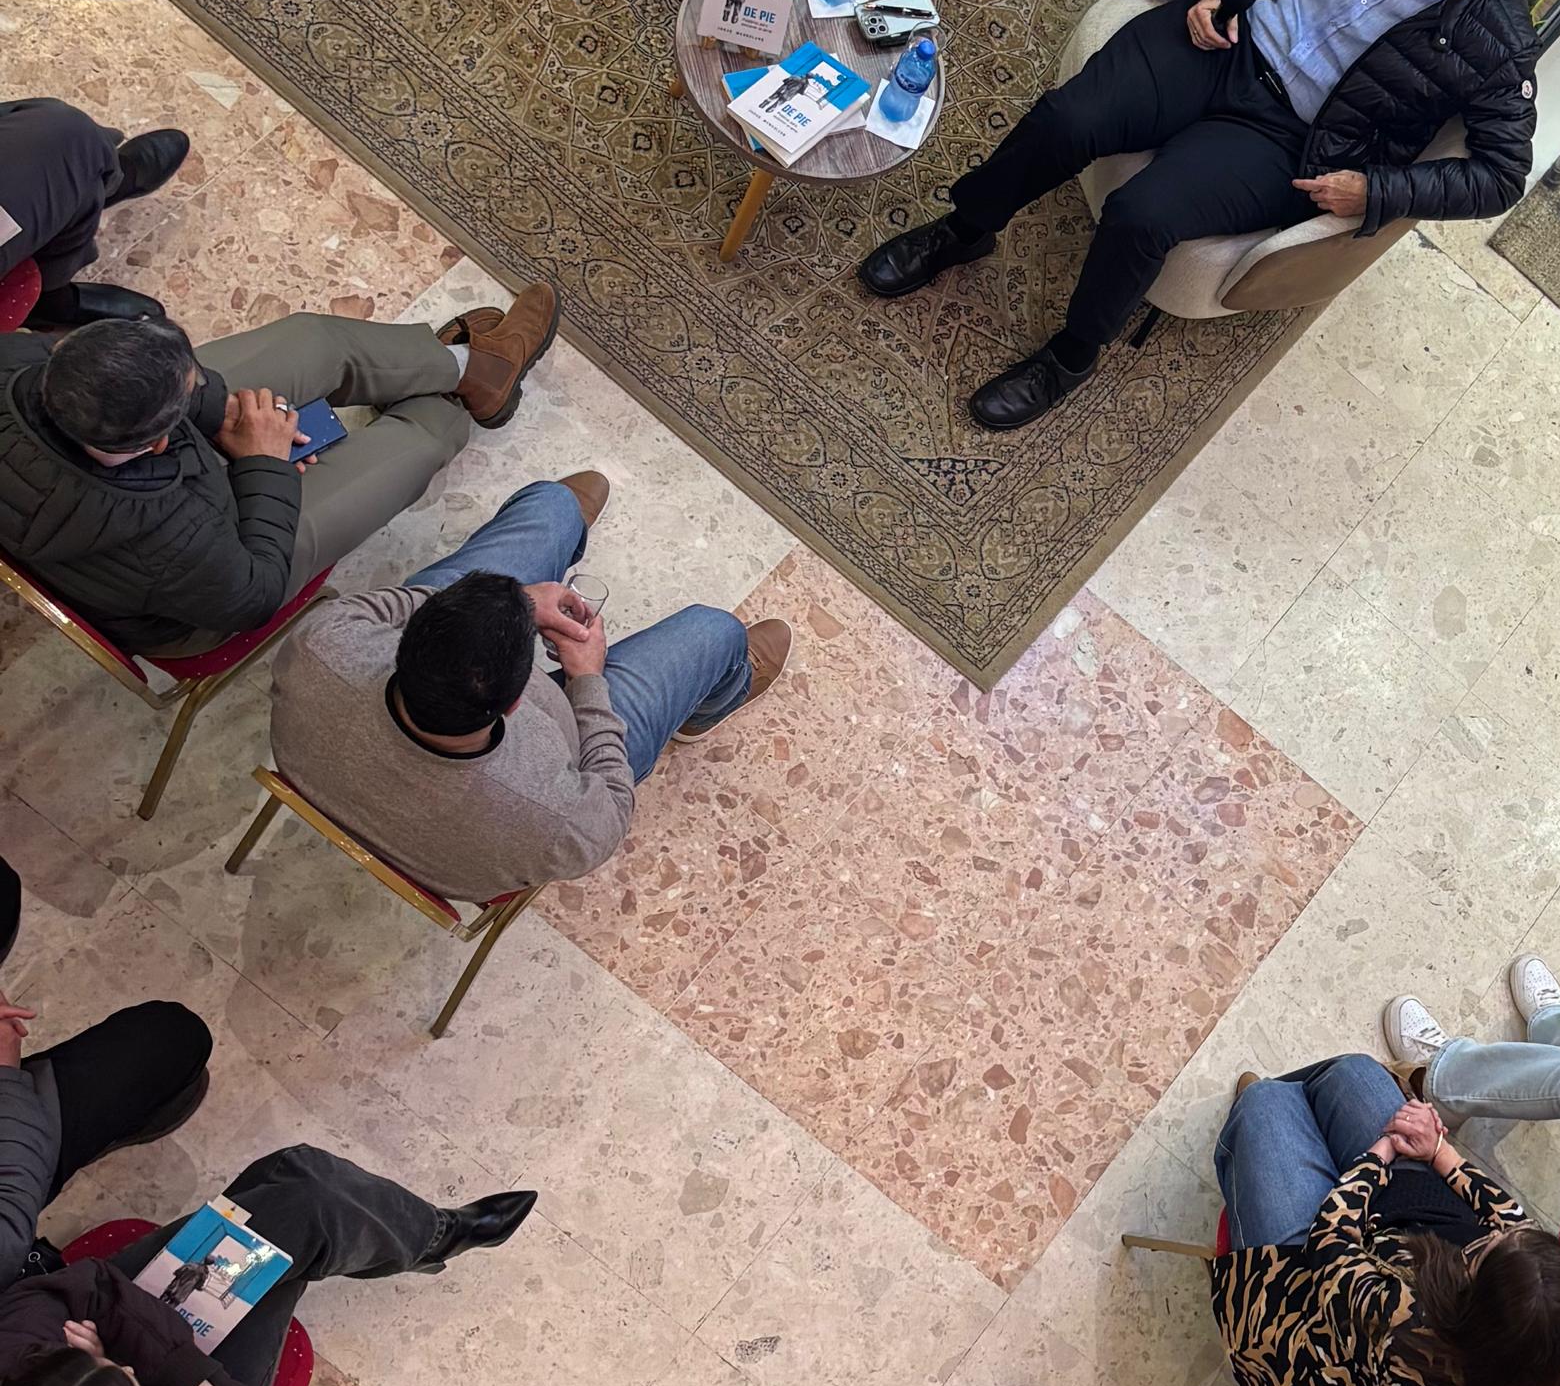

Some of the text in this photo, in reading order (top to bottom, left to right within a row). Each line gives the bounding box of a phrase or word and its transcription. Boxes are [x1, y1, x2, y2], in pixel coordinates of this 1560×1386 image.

[743, 6, 776, 24] DE PIE
[781, 104, 795, 116] DE
[793, 112, 812, 127] PIE
[192, 1318, 214, 1337] PIE
